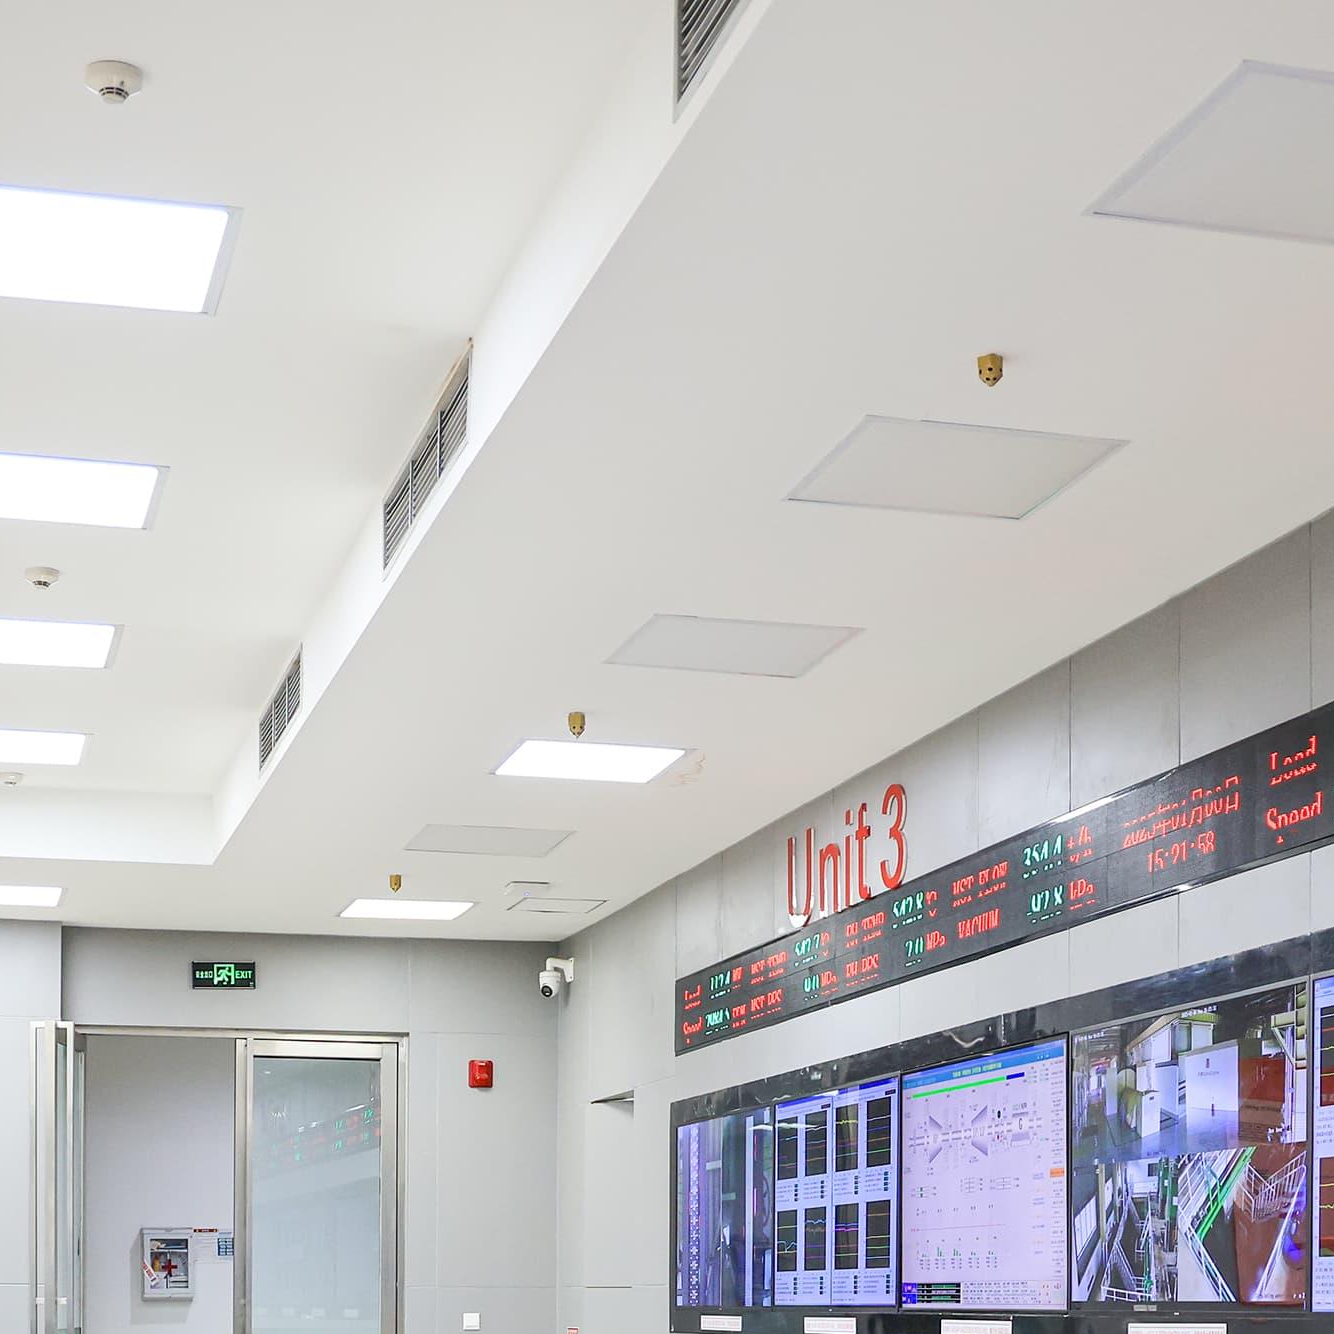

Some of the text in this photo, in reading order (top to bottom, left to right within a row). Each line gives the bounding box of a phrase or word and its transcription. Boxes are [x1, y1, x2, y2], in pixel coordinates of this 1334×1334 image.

[787, 783, 908, 927] Unit 3
[235, 970, 252, 979] EXIT
